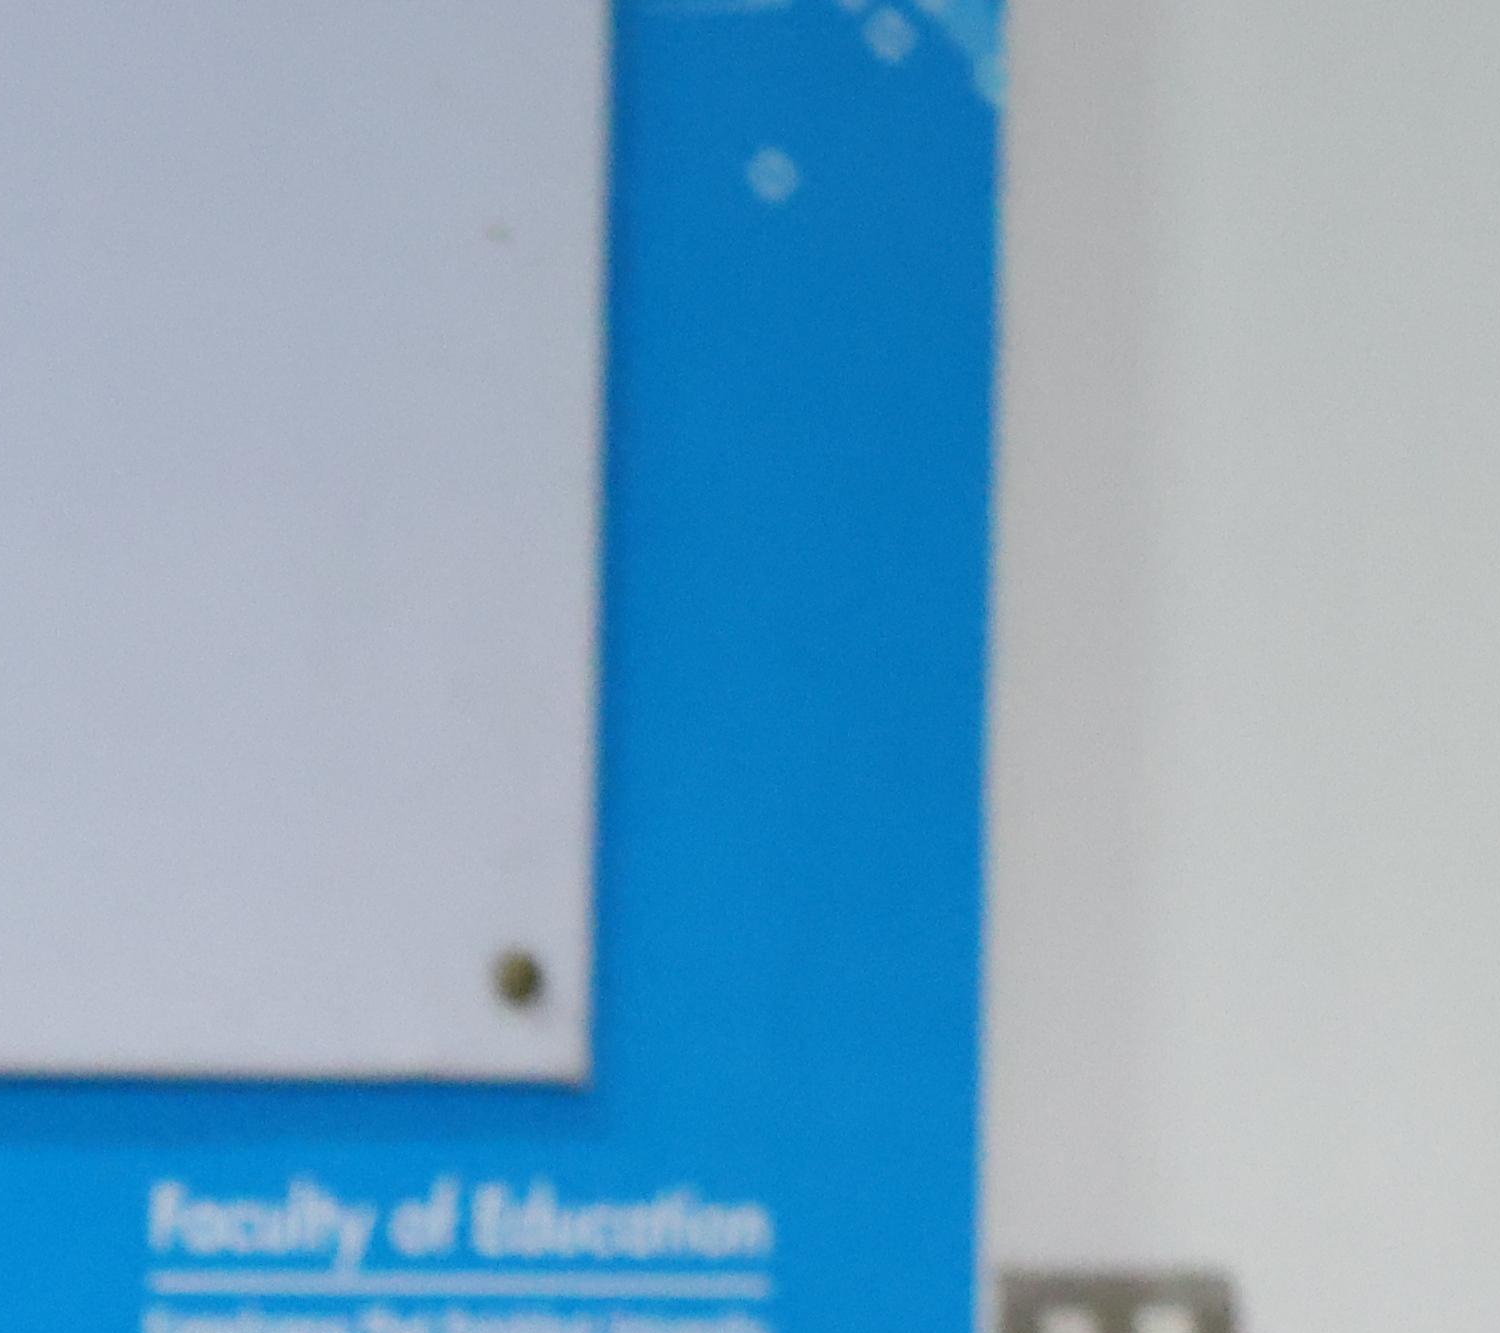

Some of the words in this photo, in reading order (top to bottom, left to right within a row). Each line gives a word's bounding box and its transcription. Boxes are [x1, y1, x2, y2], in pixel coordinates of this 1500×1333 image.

[150, 1174, 374, 1280] Faculty
[387, 1174, 459, 1255] of
[473, 1174, 773, 1257] Education
